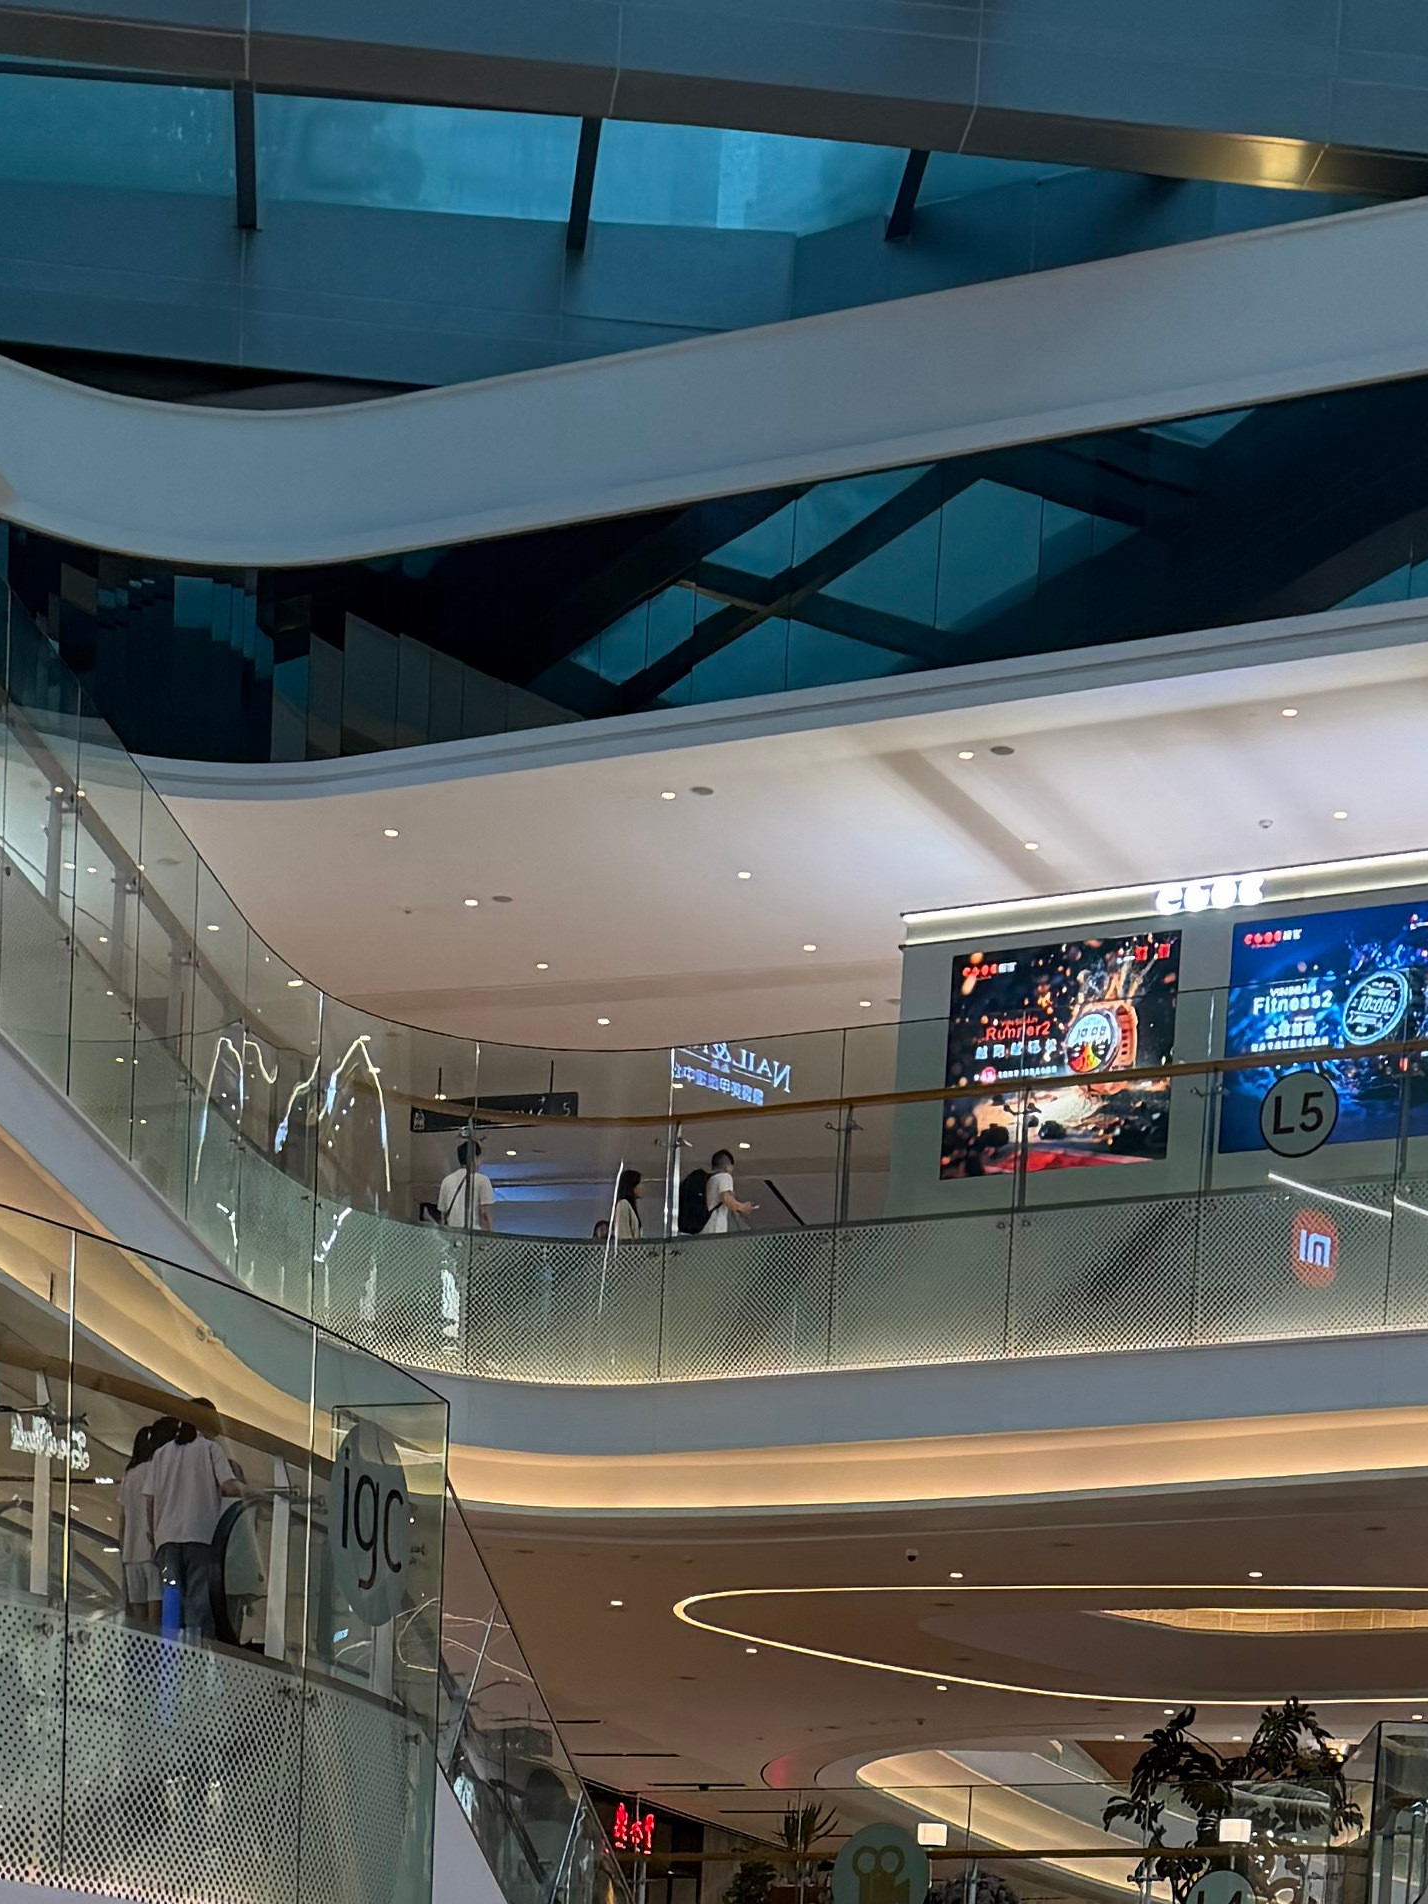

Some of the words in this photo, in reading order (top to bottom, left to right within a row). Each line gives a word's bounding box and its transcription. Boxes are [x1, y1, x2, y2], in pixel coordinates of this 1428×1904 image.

[1253, 990, 1333, 1016] Fitness2
[1272, 1091, 1325, 1136] L5
[340, 1449, 407, 1590] igc
